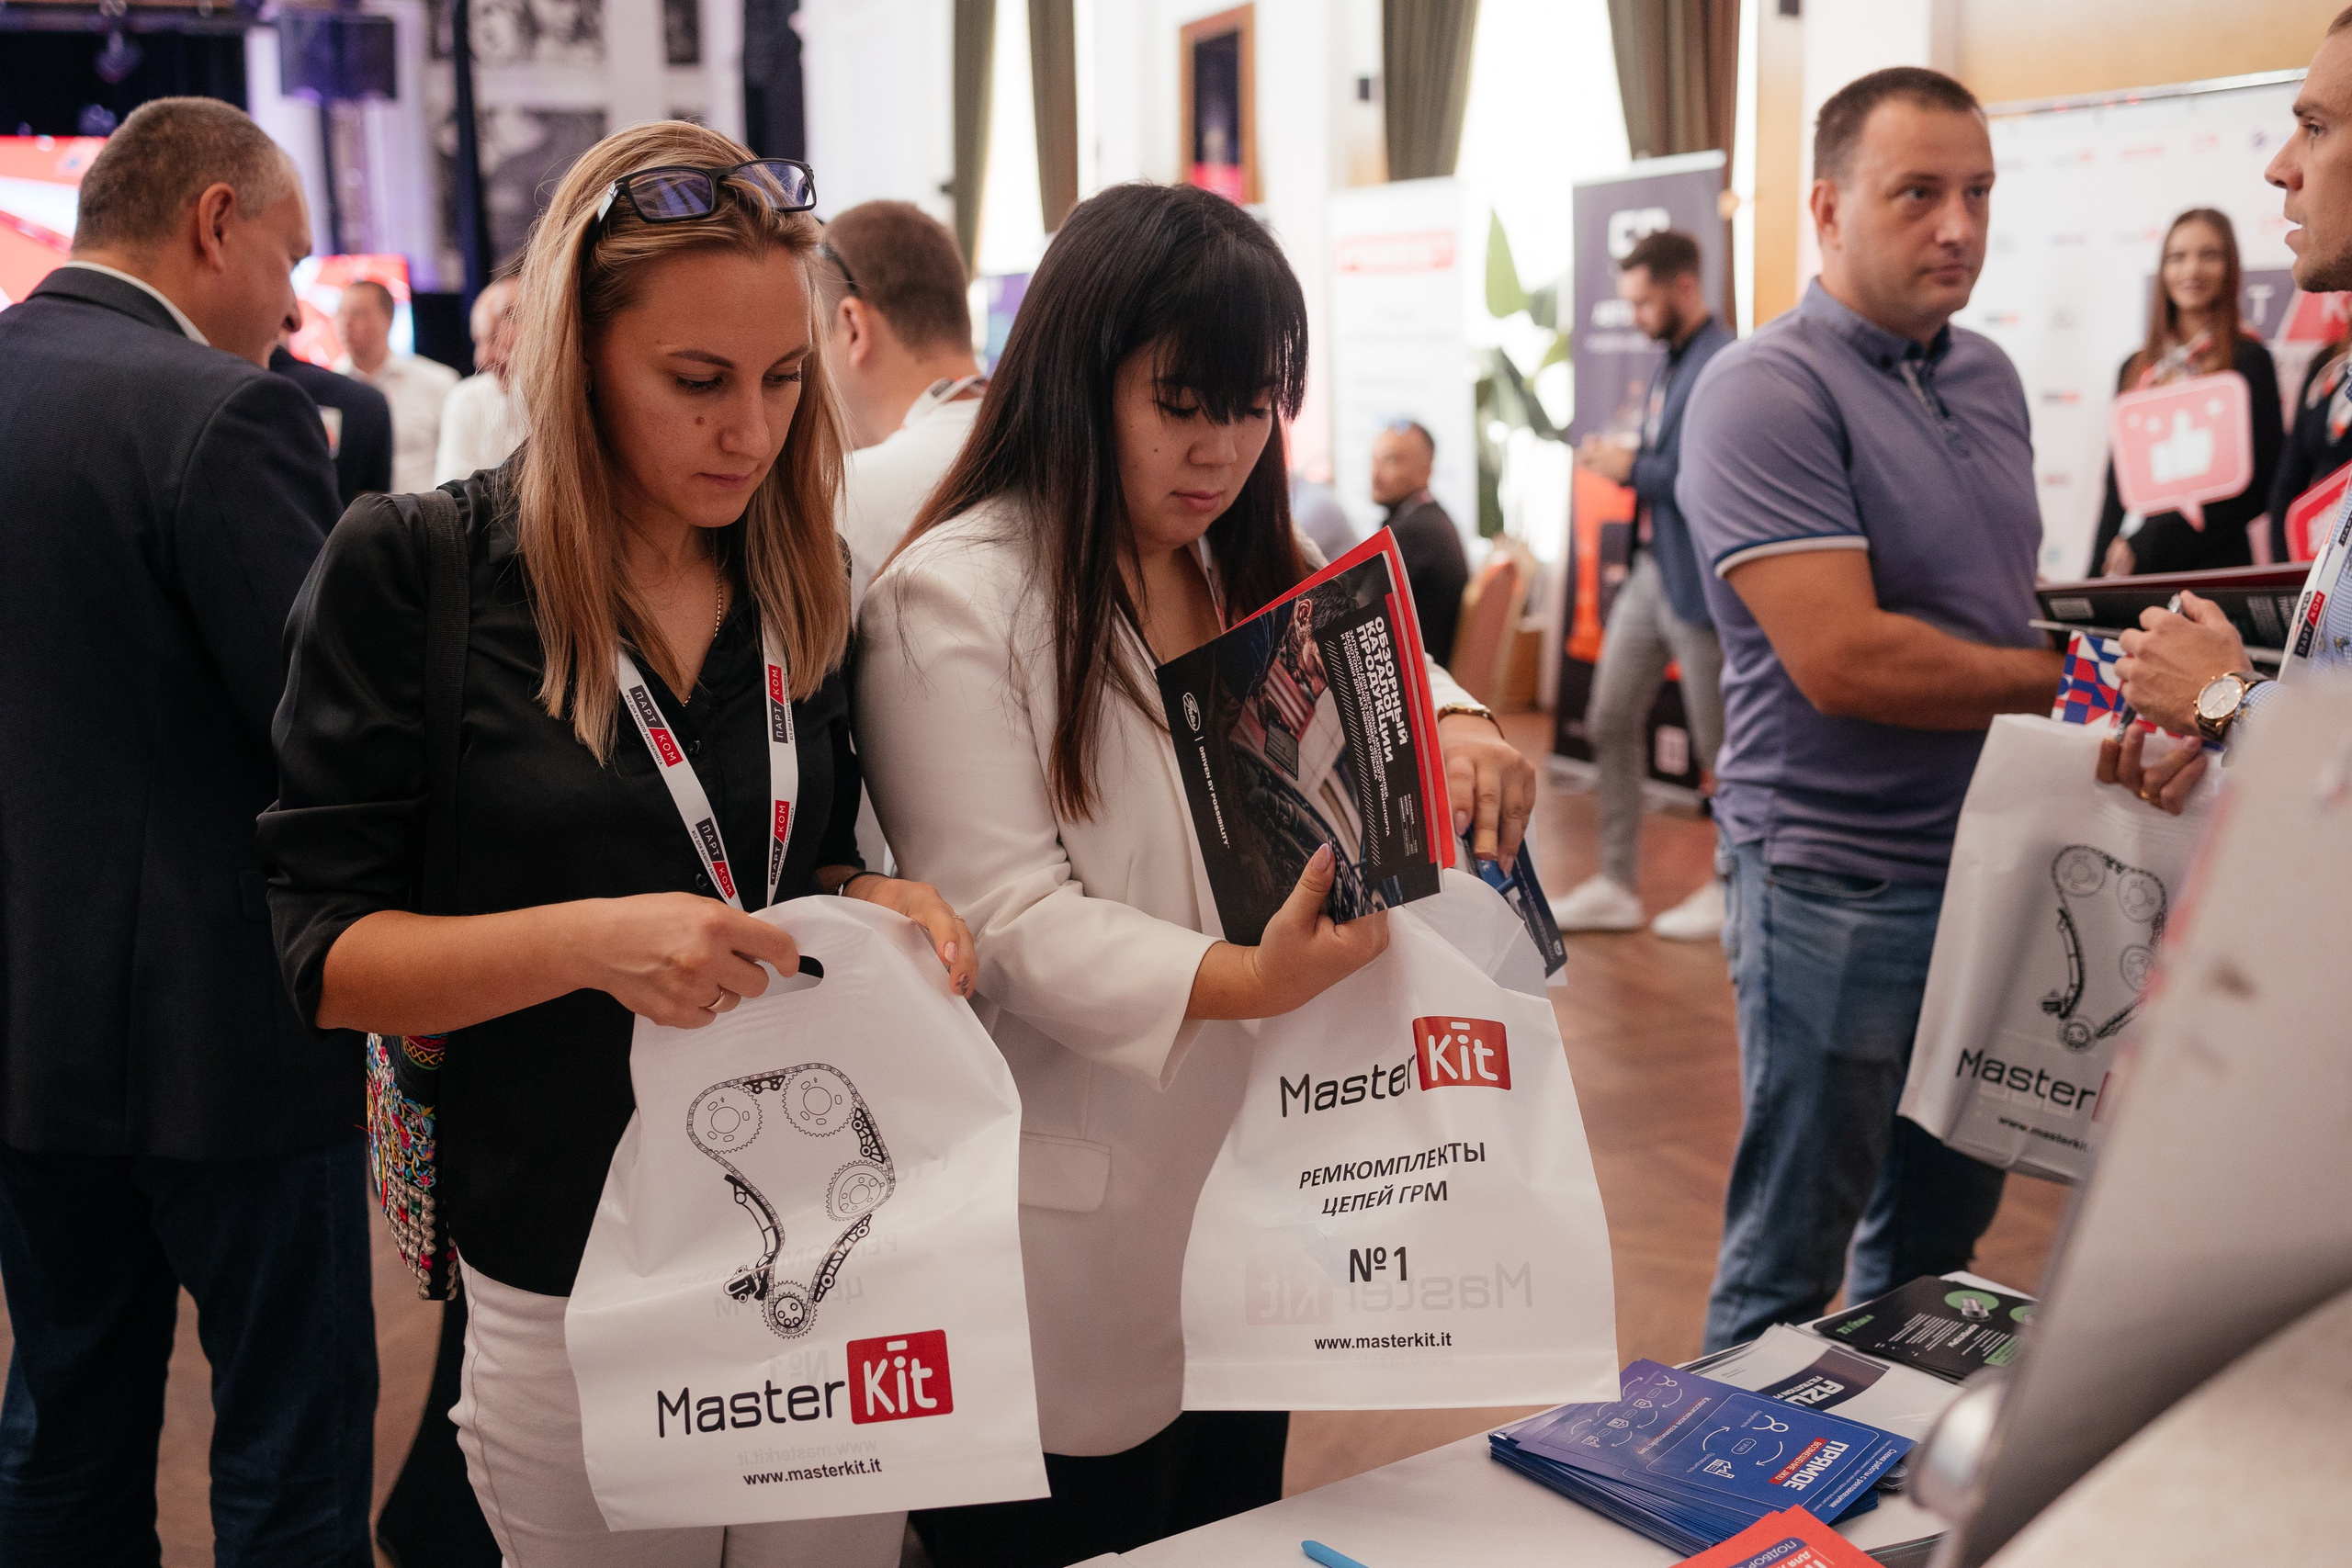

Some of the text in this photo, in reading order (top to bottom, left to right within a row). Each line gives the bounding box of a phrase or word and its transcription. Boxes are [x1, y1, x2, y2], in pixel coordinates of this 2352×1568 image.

[2298, 626, 2312, 654] ПАРТ
[2310, 593, 2323, 618] КОМ
[1348, 630, 1364, 675] ЗАПЧАСТИ
[1365, 691, 1378, 734] ЛЕГКОВЫХ
[1356, 625, 1394, 762] ПРОДУКЦИИ
[1365, 620, 1395, 723] КАТАЛОГ
[1374, 616, 1408, 746] ОБЗОРНЫЙ
[636, 691, 676, 761] ПАРТ КОМ
[774, 707, 783, 739] ПАРТ
[1341, 641, 1357, 679] ТЕХНИКИ
[1352, 678, 1361, 695] ДЛЯ
[1357, 695, 1372, 744] АКТИВНОГО
[1369, 745, 1378, 781] ОТДЫХА
[1199, 746, 1211, 779] DRIVEN
[1207, 780, 1215, 792] BY
[772, 846, 781, 879] ПАРТ
[777, 805, 786, 832] КОМ
[1380, 783, 1390, 837] ТРАНСПОРТА
[702, 825, 731, 893] ПАРТ КОМ
[1280, 1034, 1499, 1118] Master Kit
[1956, 1047, 2097, 1111] Master
[1299, 1142, 1485, 1189] РЕМКОМПЛЕКТЫ
[1322, 1181, 1448, 1216] ЦЕПЕЙ ГРМ
[1314, 1332, 1452, 1350] www.masterkit.it
[656, 1354, 938, 1438] Master Kit
[742, 1458, 882, 1486] www.masterkit.it
[1782, 1440, 1850, 1491] ПРЯМОЕ
[1748, 1540, 1797, 1568] ПОДБОР
